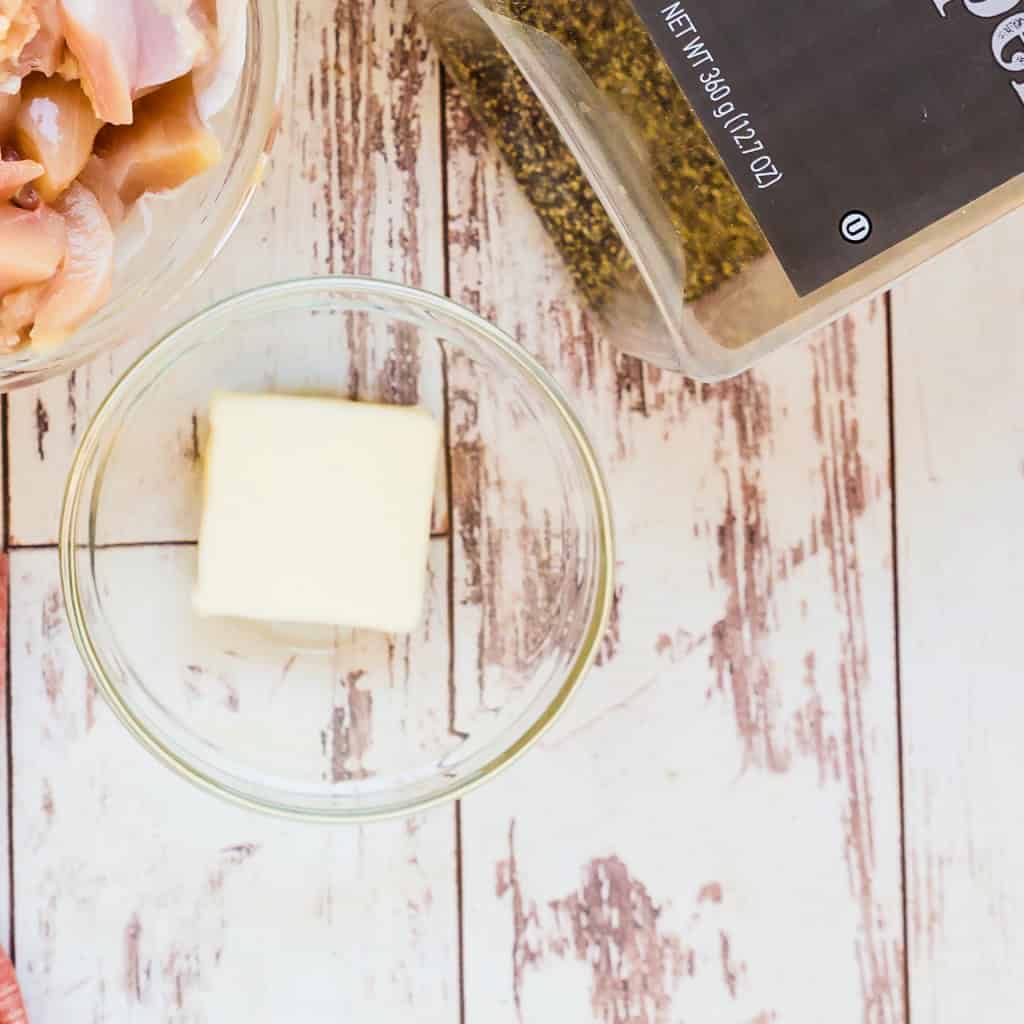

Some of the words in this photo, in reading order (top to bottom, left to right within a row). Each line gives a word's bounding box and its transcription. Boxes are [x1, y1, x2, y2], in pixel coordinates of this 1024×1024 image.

[661, 1, 697, 38] NET
[683, 36, 714, 67] WT
[699, 67, 730, 101] 360
[724, 113, 764, 154] (12.7
[750, 156, 783, 189] OZ)
